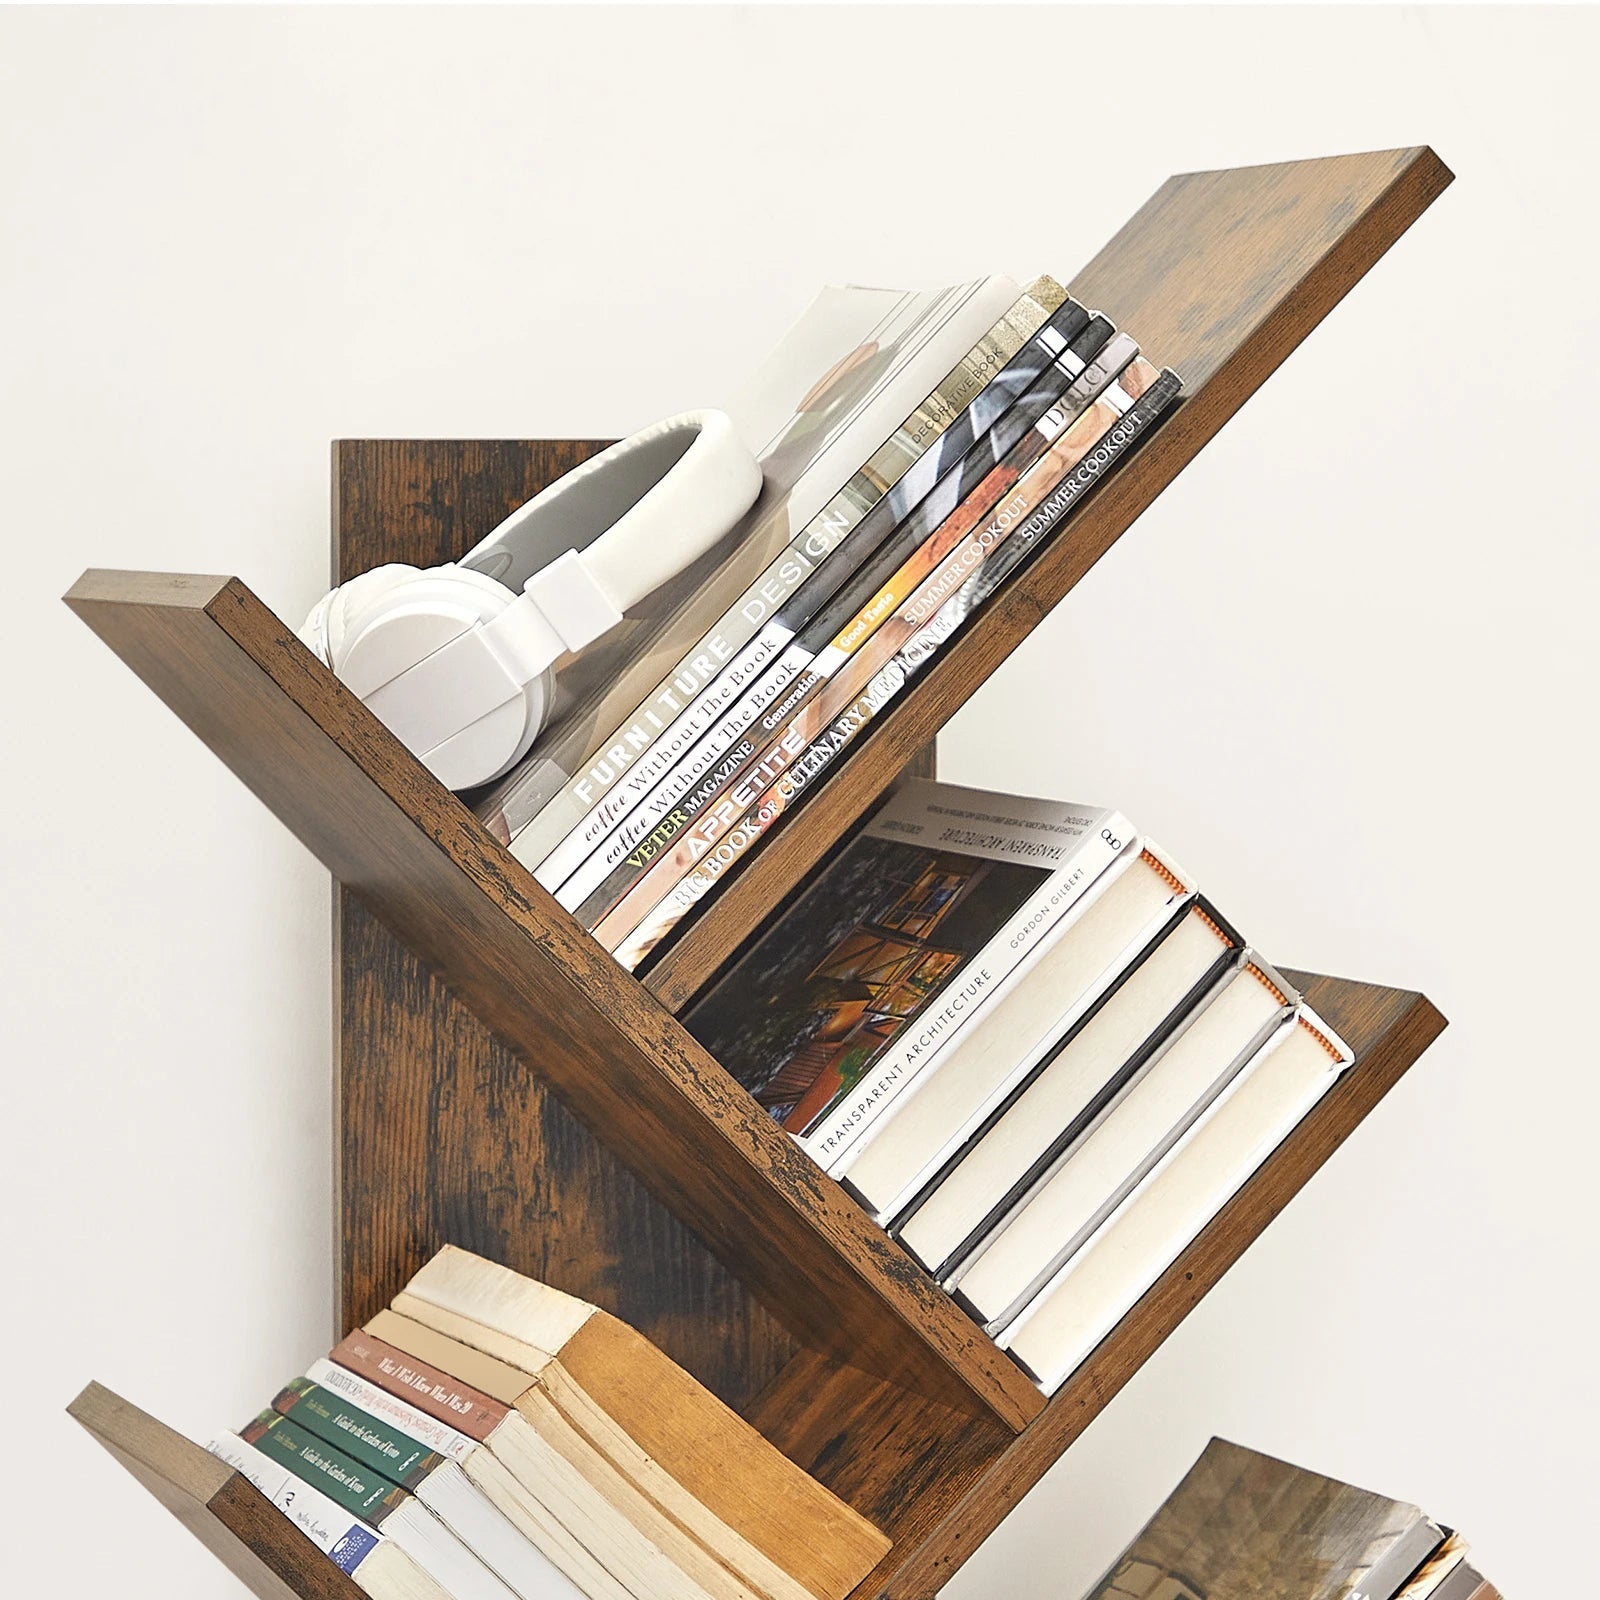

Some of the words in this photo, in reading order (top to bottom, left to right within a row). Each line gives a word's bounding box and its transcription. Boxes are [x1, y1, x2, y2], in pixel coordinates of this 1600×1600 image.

[912, 377, 974, 444] DECORATIVE
[973, 348, 1003, 380] BOOK
[1021, 479, 1081, 542] SUMMER
[1077, 411, 1144, 481] COOKOUT
[904, 563, 965, 625] SUMMER
[962, 495, 1029, 567] COOKOUT
[573, 635, 733, 805] FURNITURE
[742, 510, 850, 624] DESIGN
[839, 622, 867, 649] Good
[585, 794, 627, 841] coffee
[628, 722, 700, 792] Without
[697, 687, 731, 725] The
[730, 638, 776, 689] Book
[606, 817, 649, 864] coffee
[649, 745, 721, 815] Without
[719, 709, 752, 746] The
[752, 661, 799, 711] Book
[626, 809, 689, 869] VETER
[687, 740, 755, 814] MAGAZINE
[674, 871, 711, 909] BIG
[706, 820, 761, 877] BOOK
[777, 705, 867, 801] CULINARY
[864, 616, 952, 718] MEDICINE
[686, 725, 806, 859] APPETITE
[938, 826, 1003, 849] ARCHITECTURE
[1000, 837, 1067, 860] TRANSPARENT
[1010, 906, 1050, 950] GORDON
[1050, 867, 1086, 906] GILBERT
[820, 1064, 904, 1155] TRANSPARENT
[905, 968, 992, 1064] ARCHITECTURE
